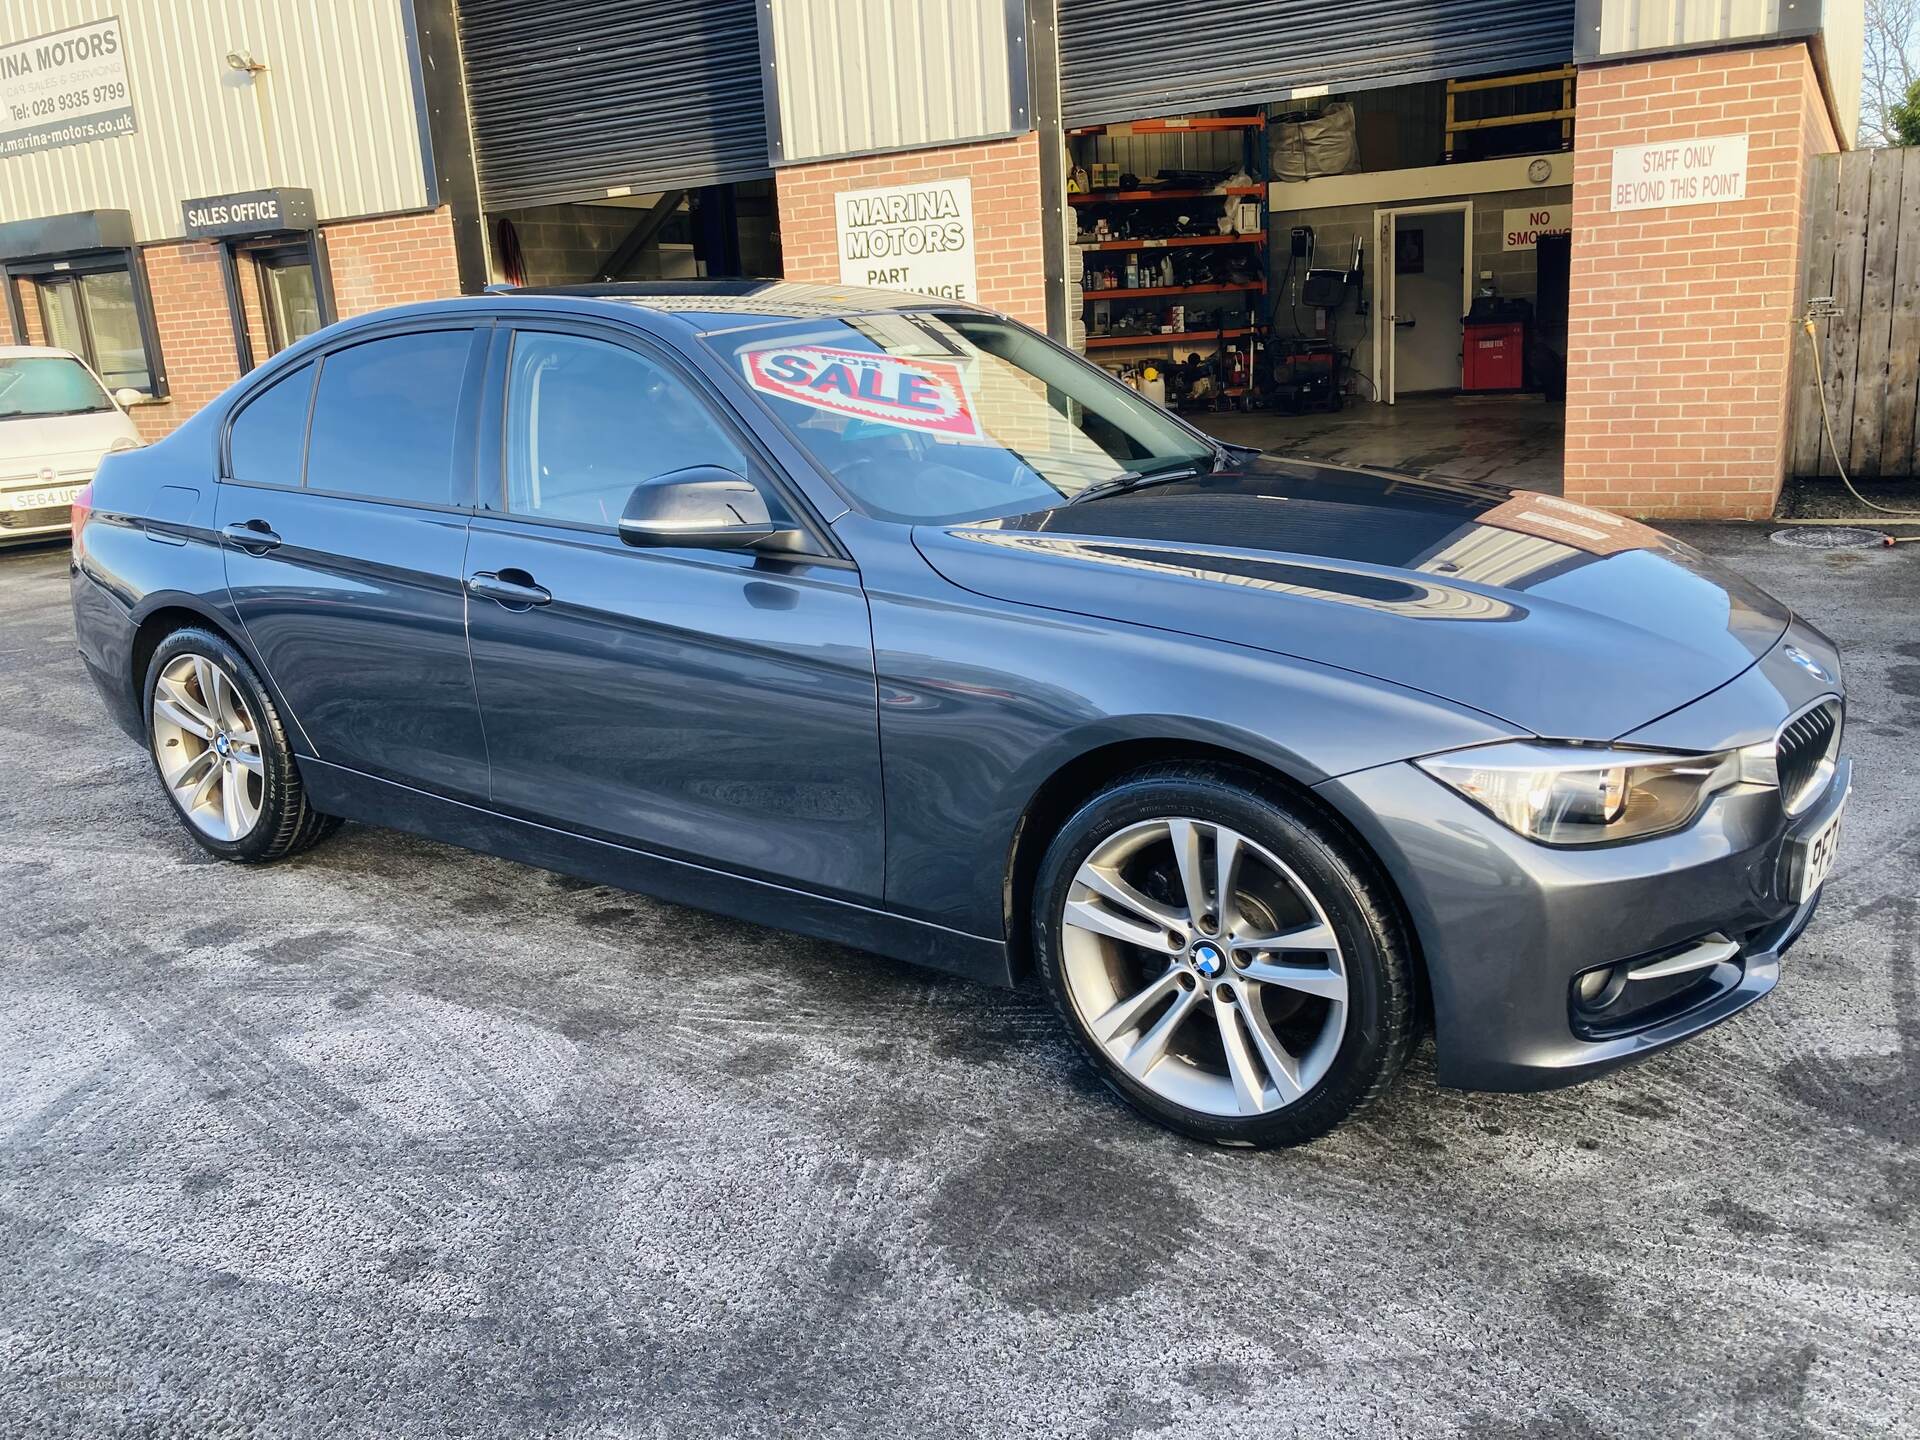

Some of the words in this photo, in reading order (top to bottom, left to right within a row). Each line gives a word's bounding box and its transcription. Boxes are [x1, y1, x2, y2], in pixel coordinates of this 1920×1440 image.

[0, 52, 33, 80] INA
[36, 29, 118, 71] MOTORS
[28, 77, 59, 93] SALES
[10, 103, 30, 121] Tel:
[32, 97, 56, 116] 028
[59, 89, 90, 111] 9335
[93, 82, 125, 104] 9799
[1643, 149, 1680, 173] STAFF
[1684, 145, 1716, 169] ONLY
[1616, 180, 1666, 205] BEYOND
[1670, 176, 1698, 200] THIS
[1702, 173, 1740, 197] POINT
[188, 206, 229, 227] SALES
[230, 200, 279, 222] OFFICE
[847, 189, 960, 228] MARINA
[1529, 211, 1551, 226] NO
[846, 221, 965, 260] MOTORS
[867, 267, 910, 285] PART
[821, 354, 881, 369] FOR
[764, 354, 945, 415] SALE
[16, 492, 56, 507] SE64
